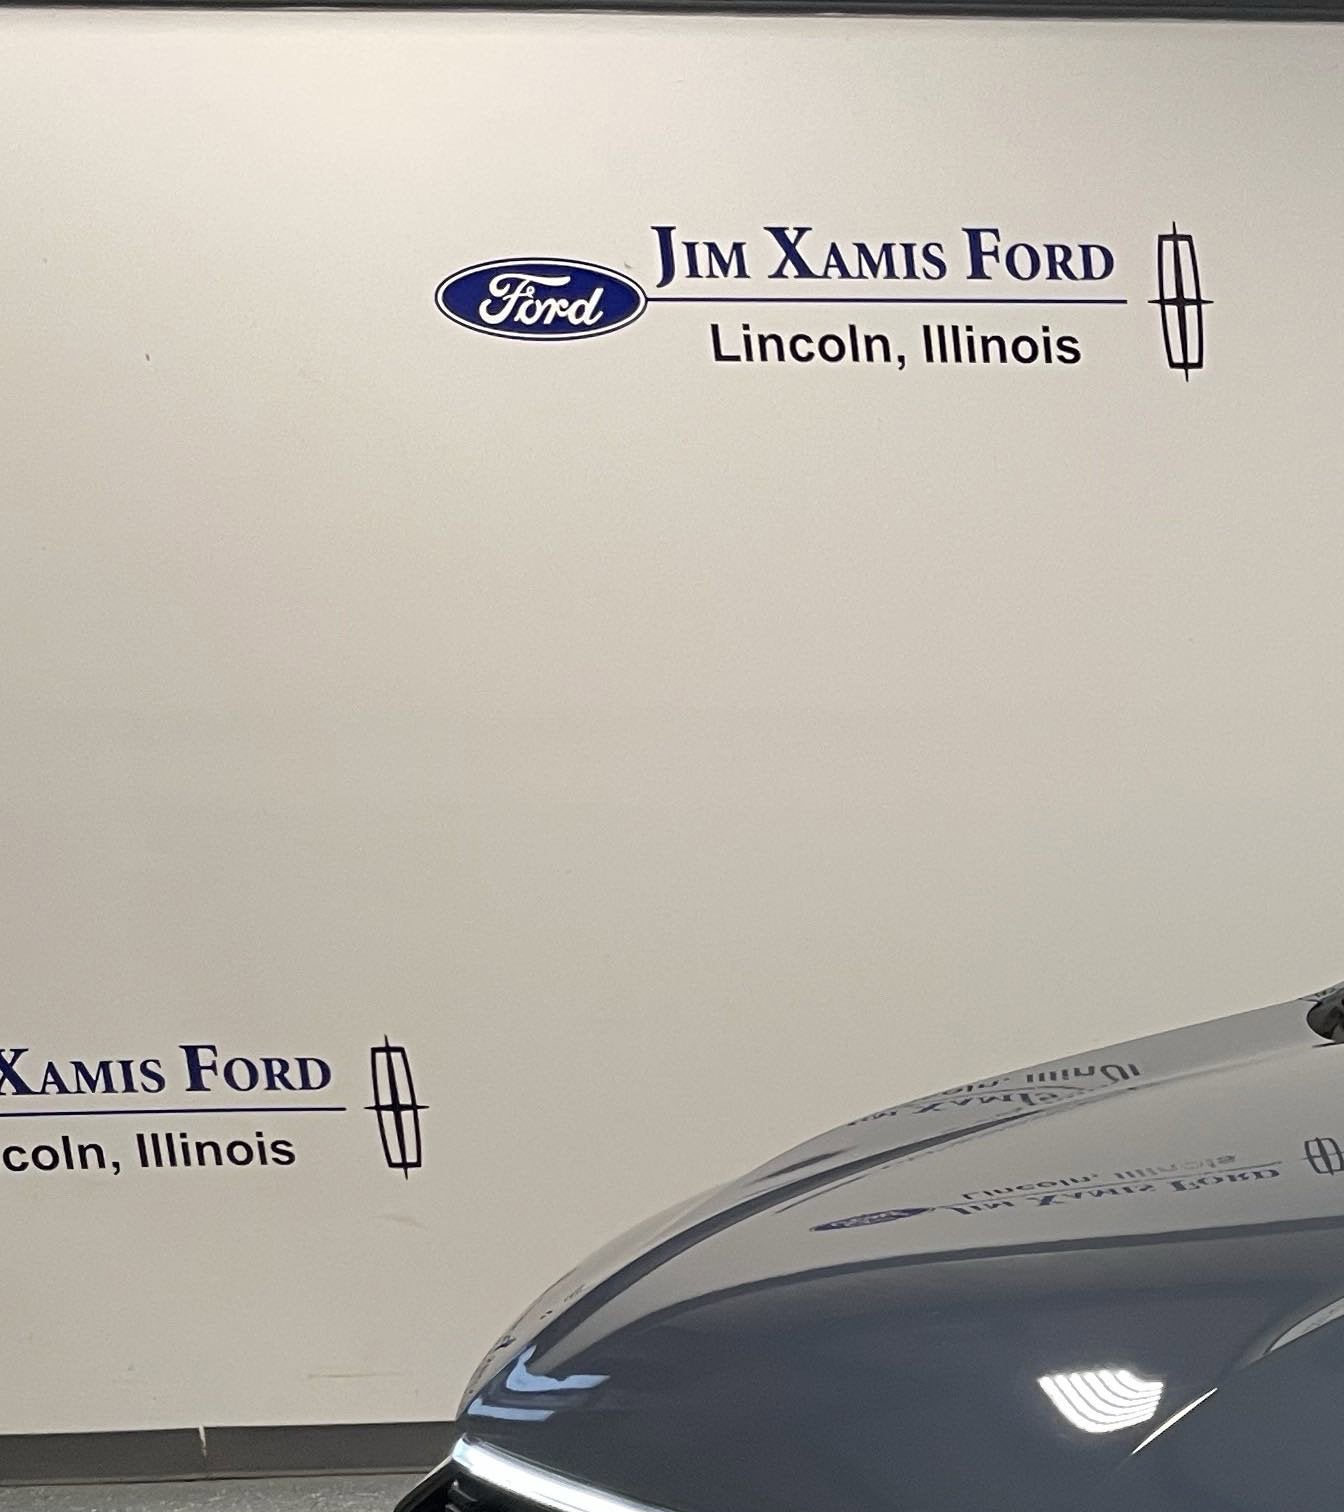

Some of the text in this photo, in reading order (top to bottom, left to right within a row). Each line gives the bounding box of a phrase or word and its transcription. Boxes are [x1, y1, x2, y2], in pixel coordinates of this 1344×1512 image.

[651, 225, 1115, 288] JIM XAMIS FORD
[479, 273, 603, 327] Ford
[711, 323, 1082, 369] Lincoln, Illinois
[178, 1044, 331, 1092] FORD
[1, 1131, 296, 1175] coln, Illinois
